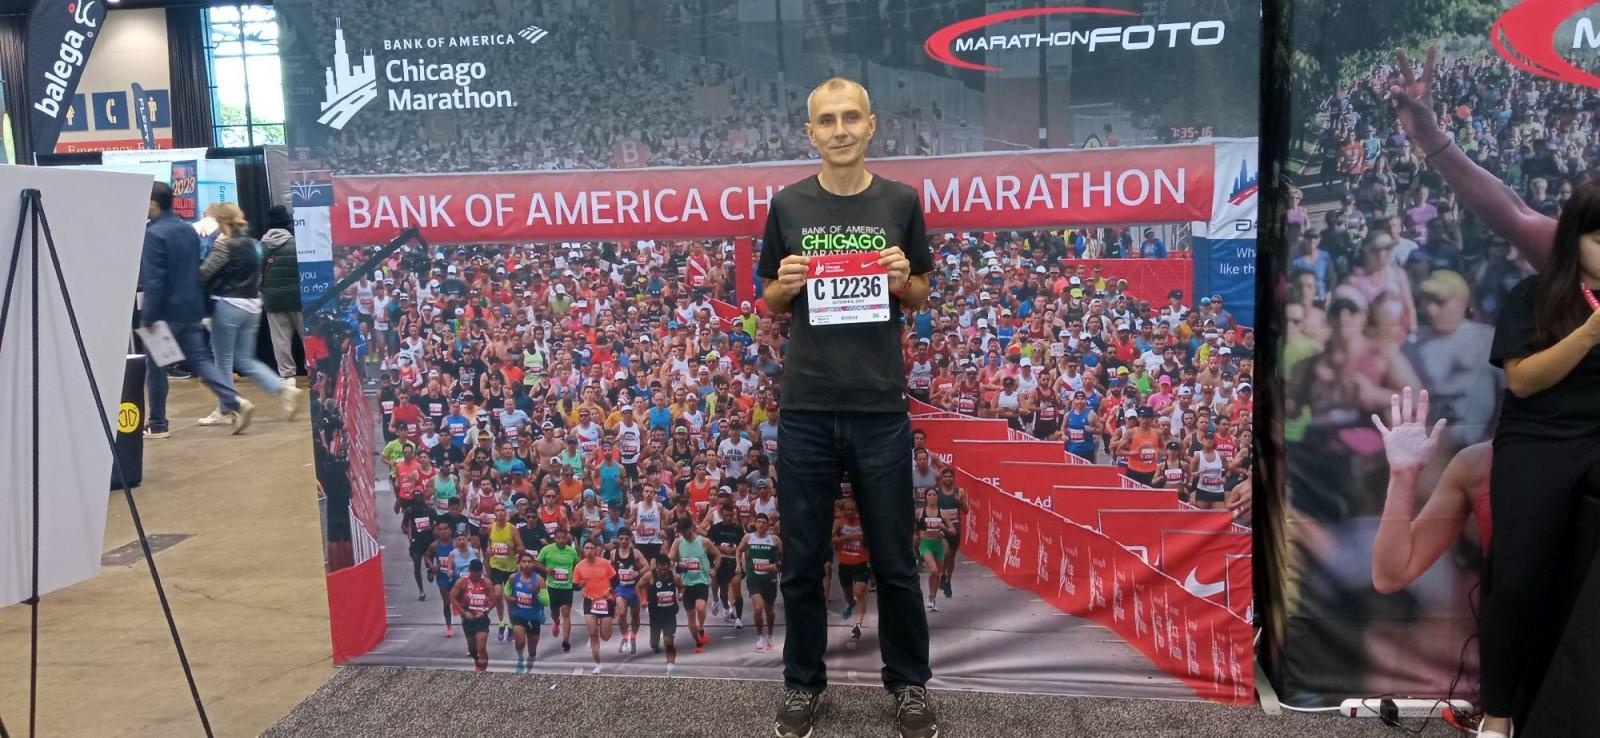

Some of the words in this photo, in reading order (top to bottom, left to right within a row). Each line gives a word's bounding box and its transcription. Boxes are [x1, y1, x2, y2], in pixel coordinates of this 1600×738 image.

[384, 38, 423, 51] BANK
[426, 37, 445, 49] OF
[448, 34, 516, 48] AMERICA
[34, 29, 85, 118] balega
[385, 58, 486, 87] Chicago
[137, 142, 161, 150] Eit
[172, 177, 196, 196] 2023
[348, 194, 455, 228] BANK
[465, 193, 515, 227] OF
[526, 188, 708, 226] AMERICA
[720, 185, 785, 221] CH
[923, 167, 1186, 213] MARATHON
[802, 226, 826, 235] BANK
[830, 226, 843, 234] OF
[845, 226, 886, 235] AMERICA
[802, 233, 887, 250] CHICAGO
[300, 271, 317, 282] you
[1220, 263, 1240, 275] like
[814, 278, 826, 301] C
[830, 275, 882, 300] 12236
